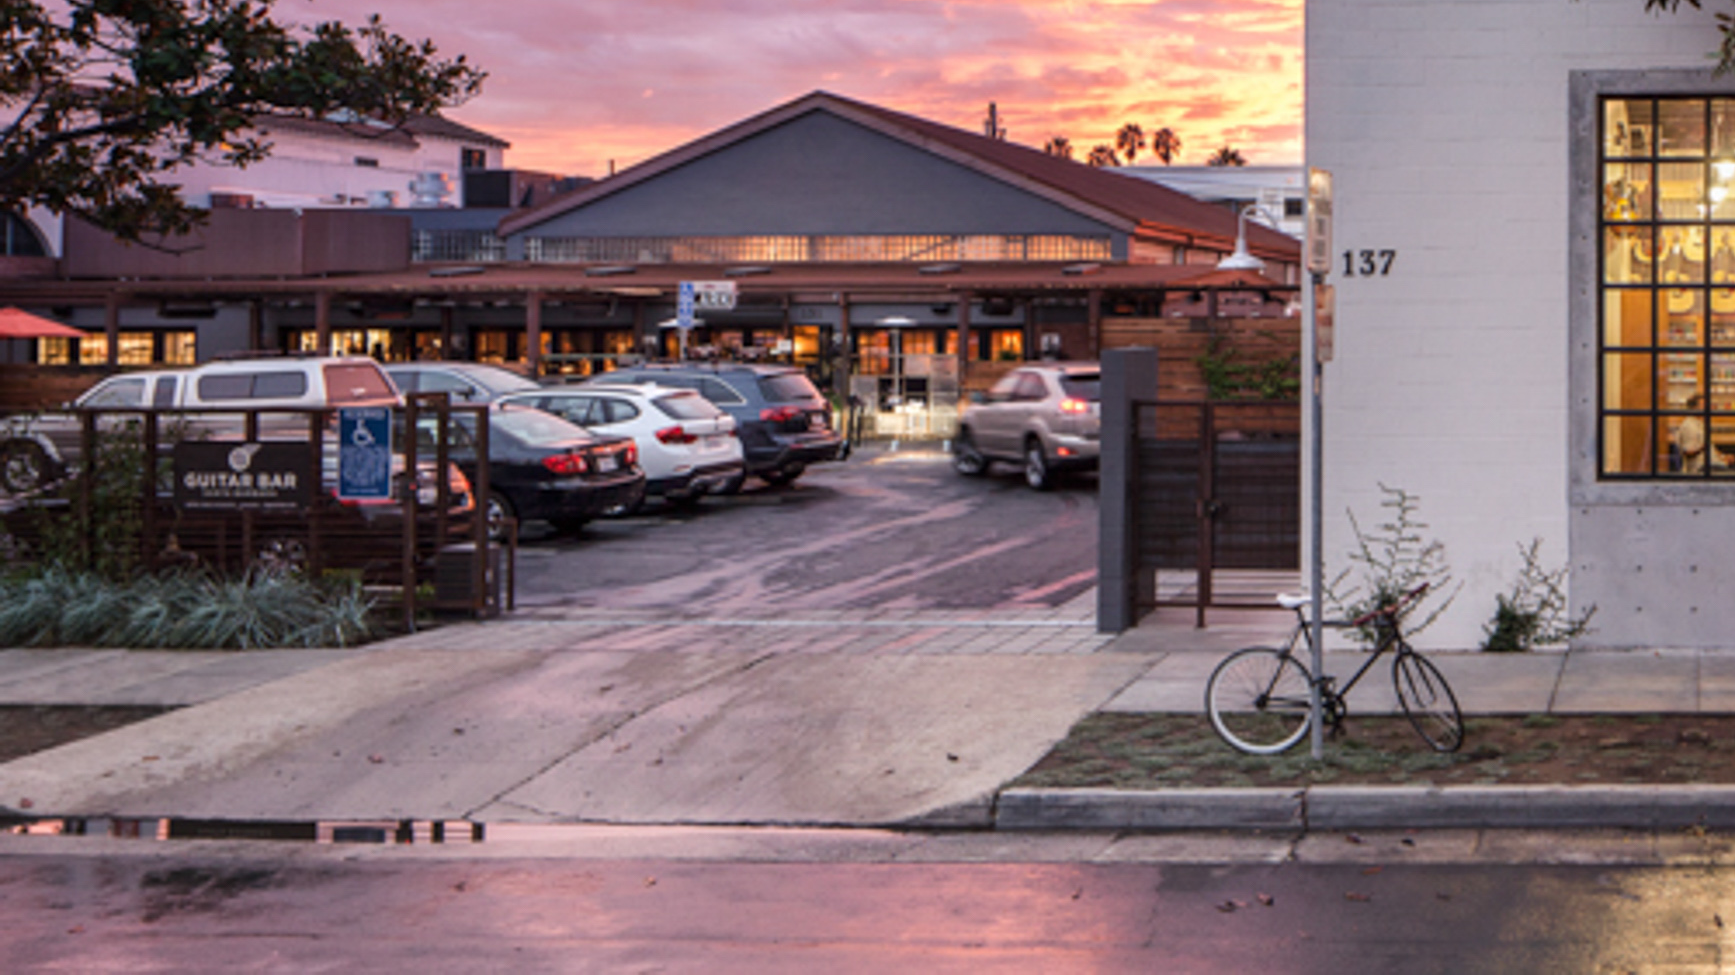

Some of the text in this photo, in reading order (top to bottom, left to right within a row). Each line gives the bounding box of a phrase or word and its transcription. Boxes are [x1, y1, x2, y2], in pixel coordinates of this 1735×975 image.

[1342, 249, 1396, 277] 137
[183, 471, 297, 489] GUITAR BAR
